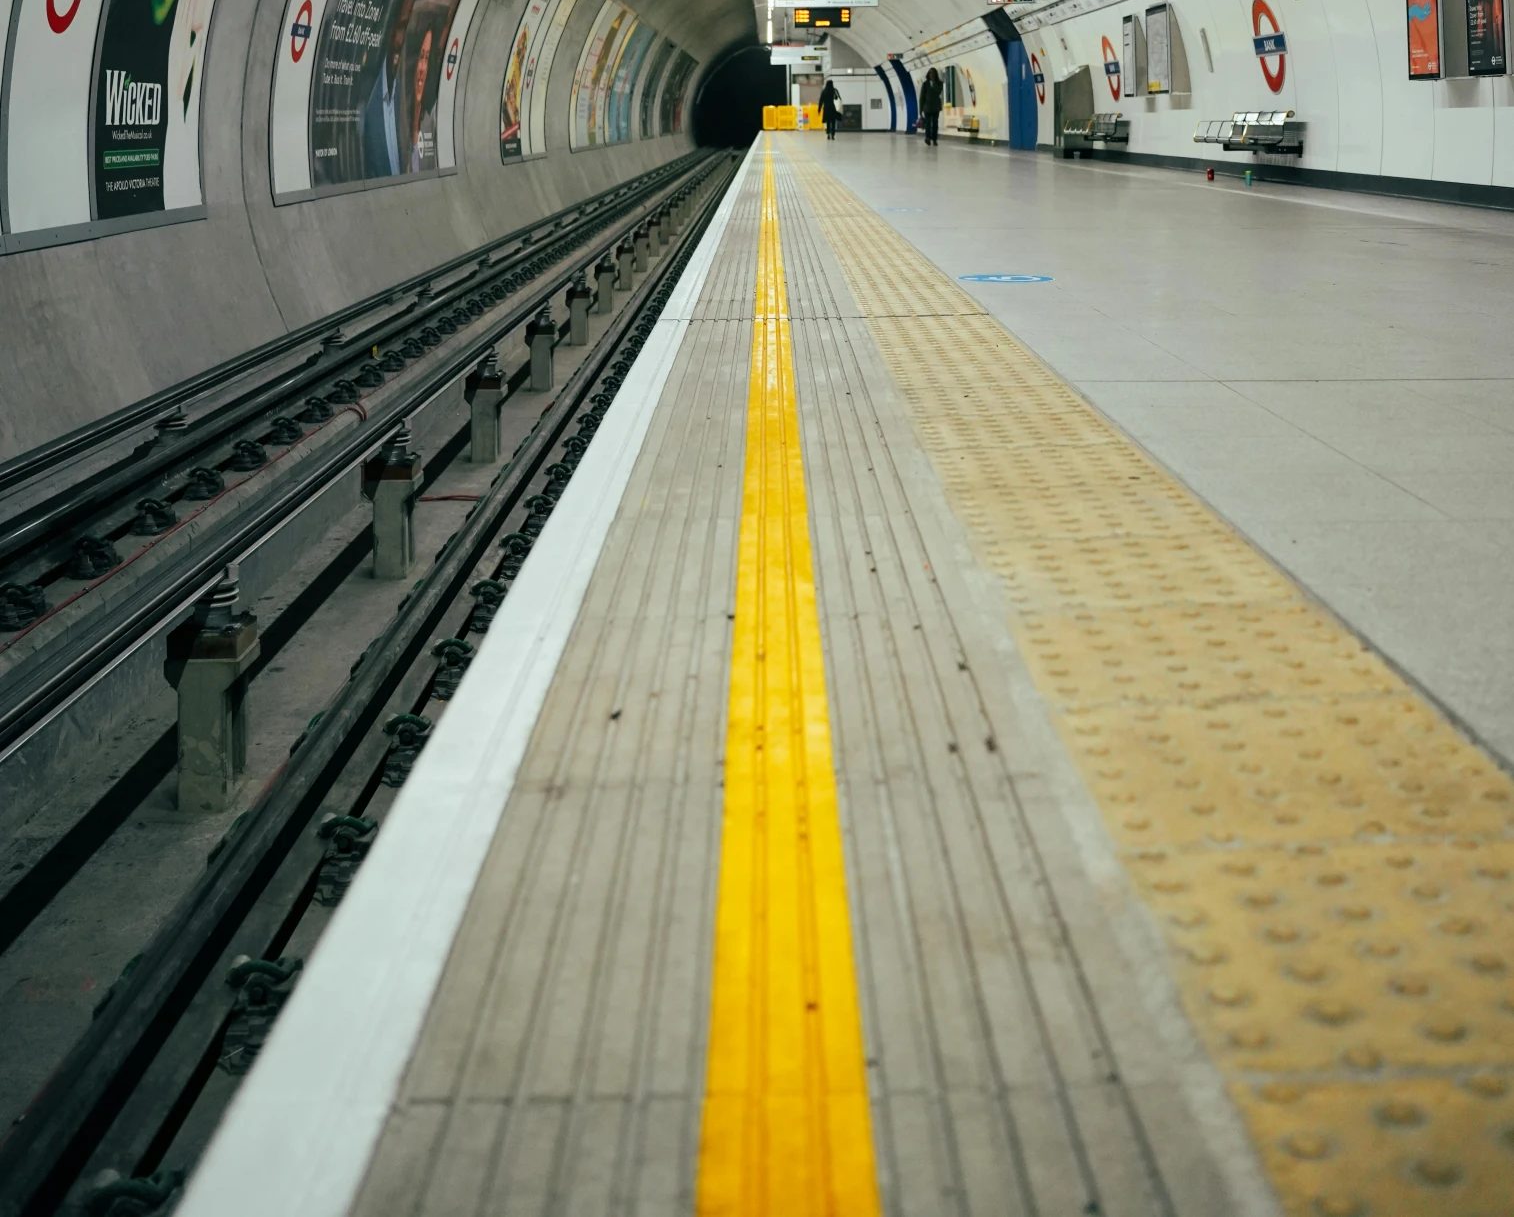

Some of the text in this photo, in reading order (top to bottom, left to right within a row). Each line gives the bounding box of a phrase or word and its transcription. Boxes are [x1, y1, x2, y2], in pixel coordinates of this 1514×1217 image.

[365, 0, 380, 22] Zone
[330, 20, 346, 41] from
[360, 26, 383, 50] off-peak
[1263, 38, 1276, 52] BANK
[105, 177, 160, 192] THE APOLLO VICTORIA THEATRE
